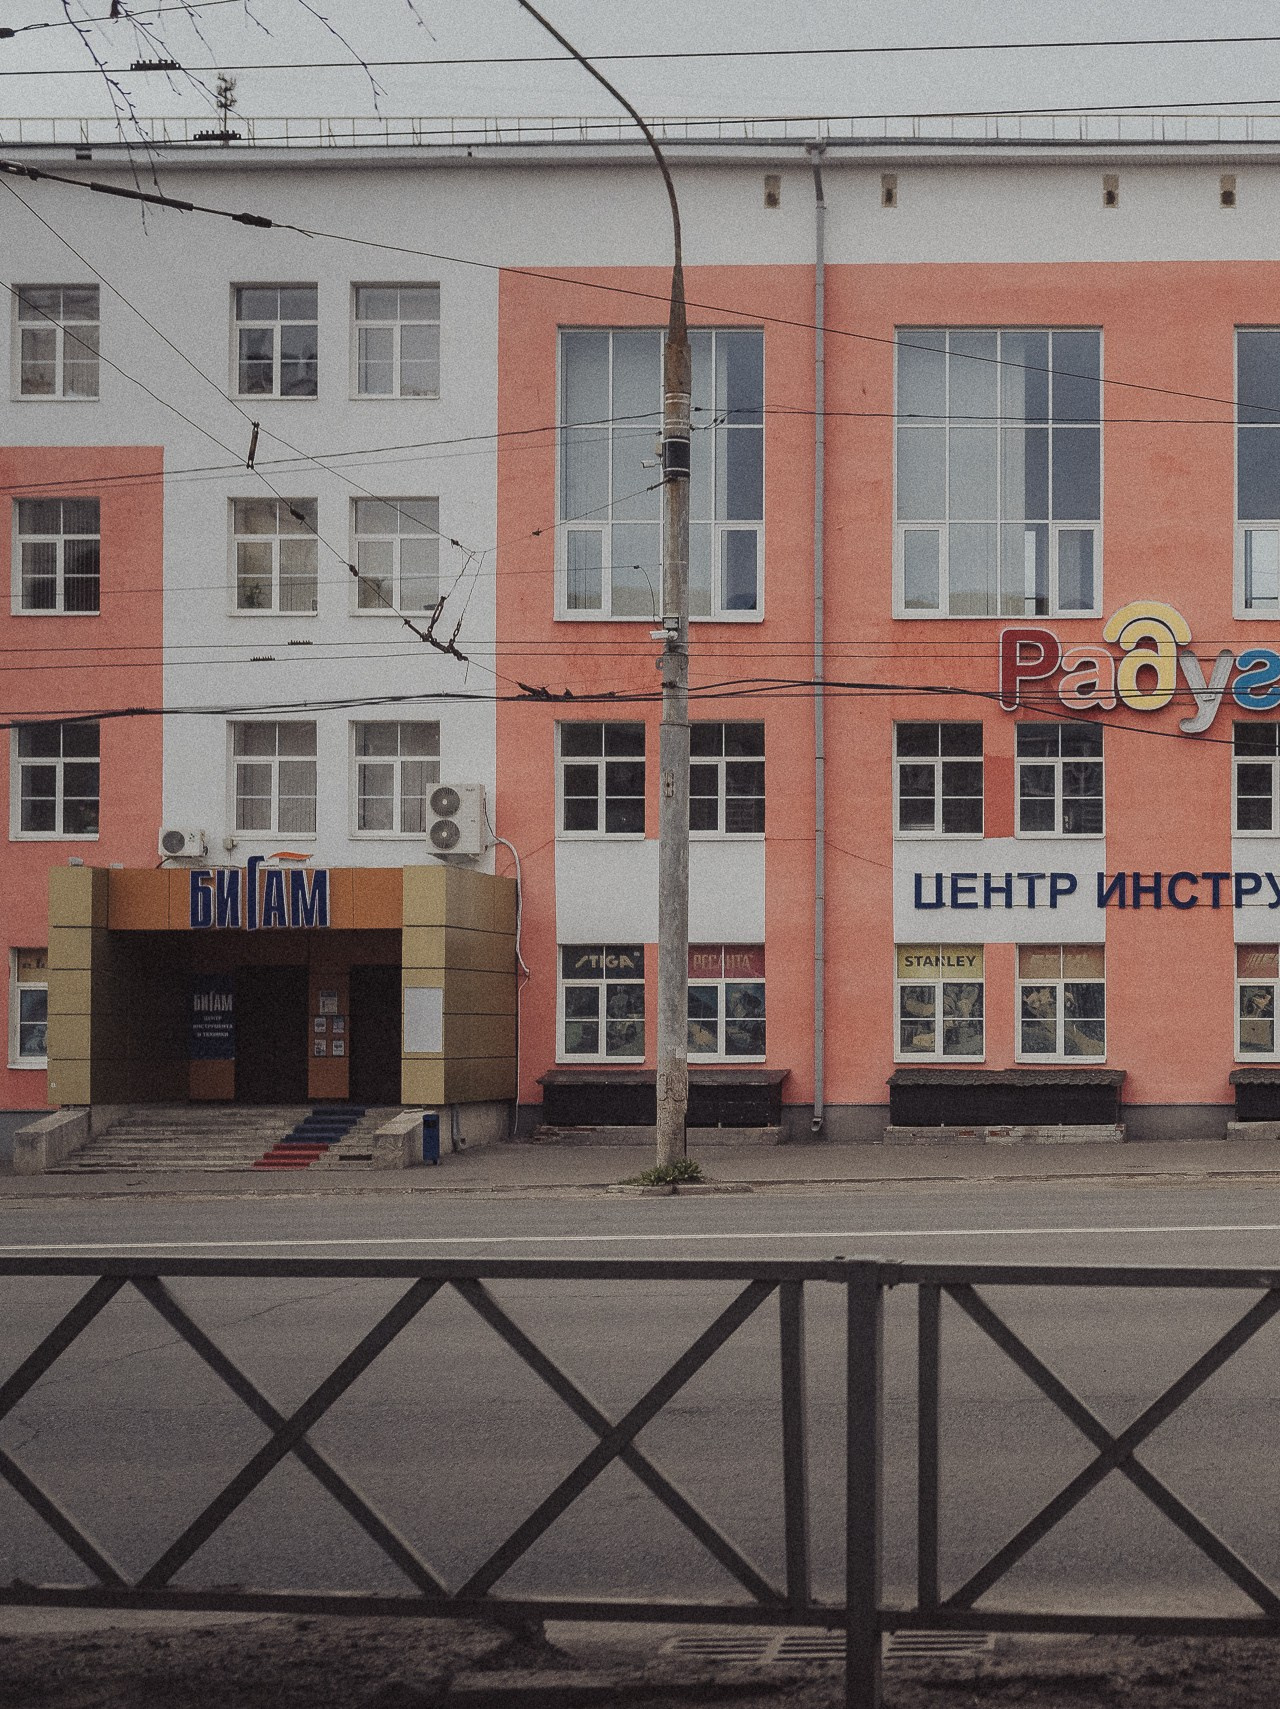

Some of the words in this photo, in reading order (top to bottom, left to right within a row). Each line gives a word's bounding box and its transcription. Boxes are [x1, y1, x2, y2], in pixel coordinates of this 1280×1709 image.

[190, 855, 330, 931] БИГАМ
[914, 872, 1078, 909] ЦЕНТР
[575, 955, 634, 968] STIGA
[693, 954, 751, 971] РЕСАНТА
[904, 955, 977, 967] STANLEY
